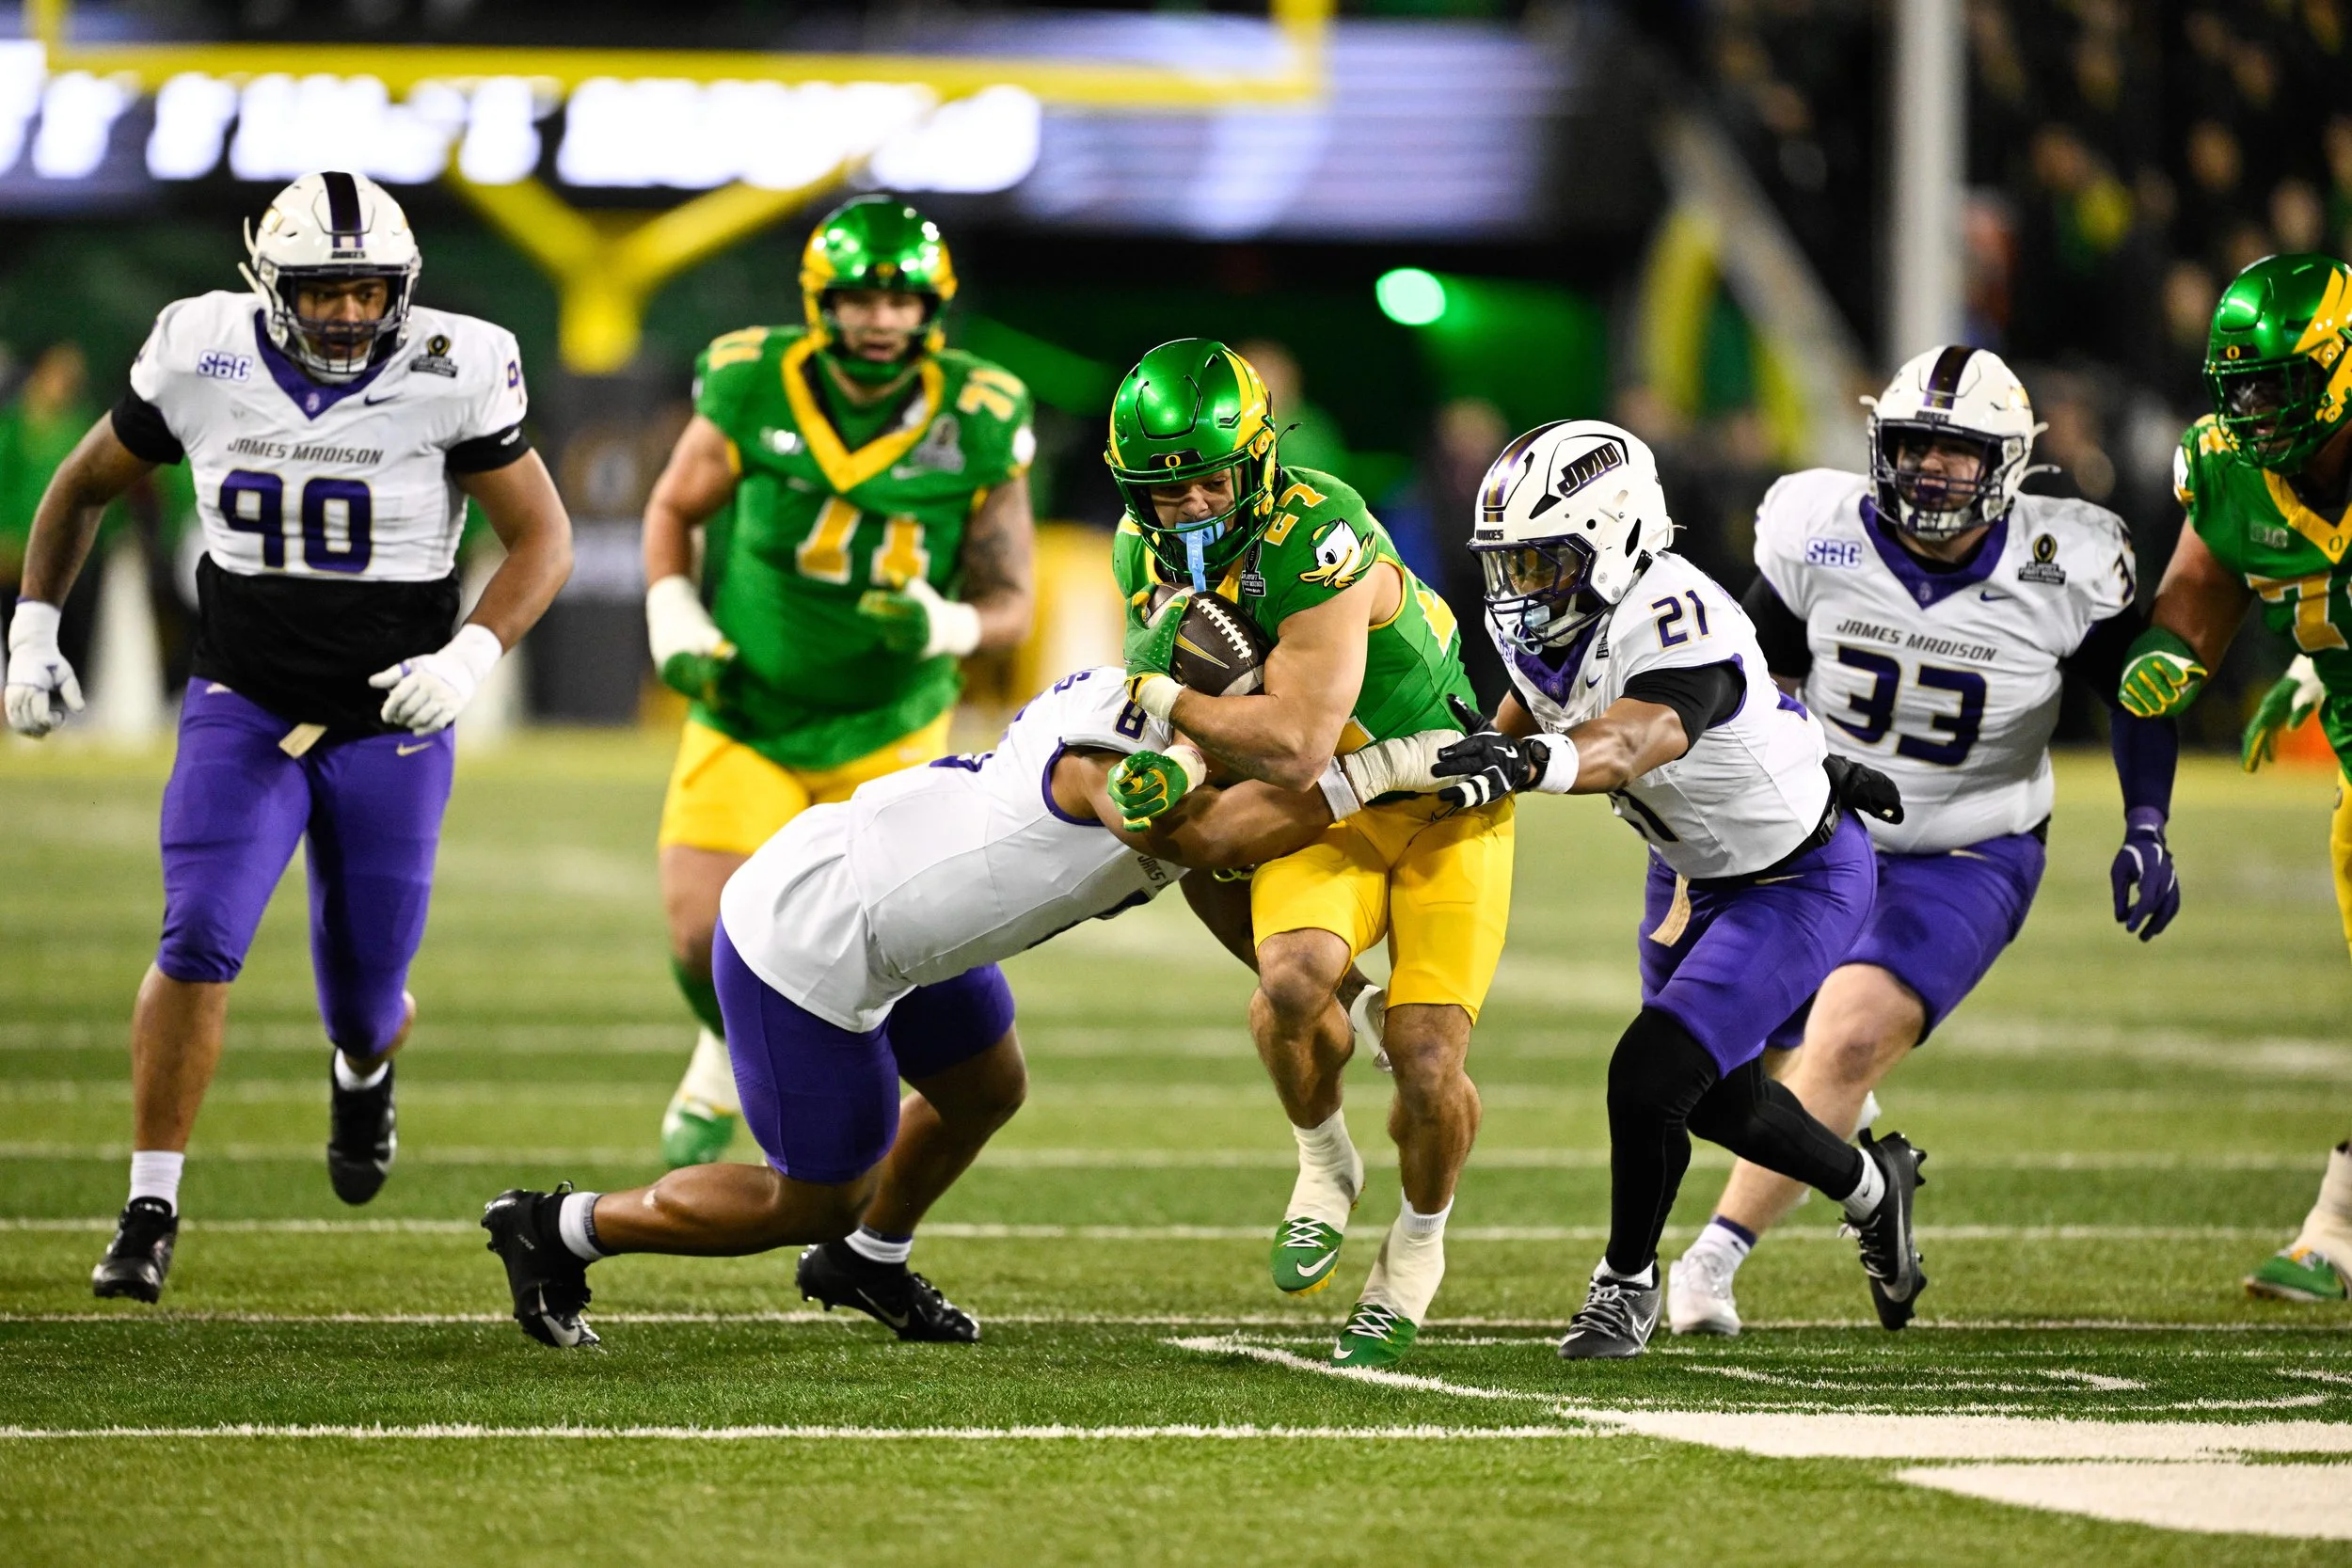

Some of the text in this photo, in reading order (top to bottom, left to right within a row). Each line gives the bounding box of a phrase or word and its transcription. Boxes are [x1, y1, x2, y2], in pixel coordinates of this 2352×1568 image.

[197, 349, 252, 382] SBC
[228, 437, 385, 465] JAMES MADISON
[1557, 442, 1624, 498] JMU
[218, 468, 373, 575] 90
[1264, 483, 1328, 546] 27
[1805, 537, 1862, 570] SBC
[1650, 589, 1713, 652] 21
[1836, 618, 1997, 662] JAMES MADISON
[1826, 644, 1988, 768] 33
